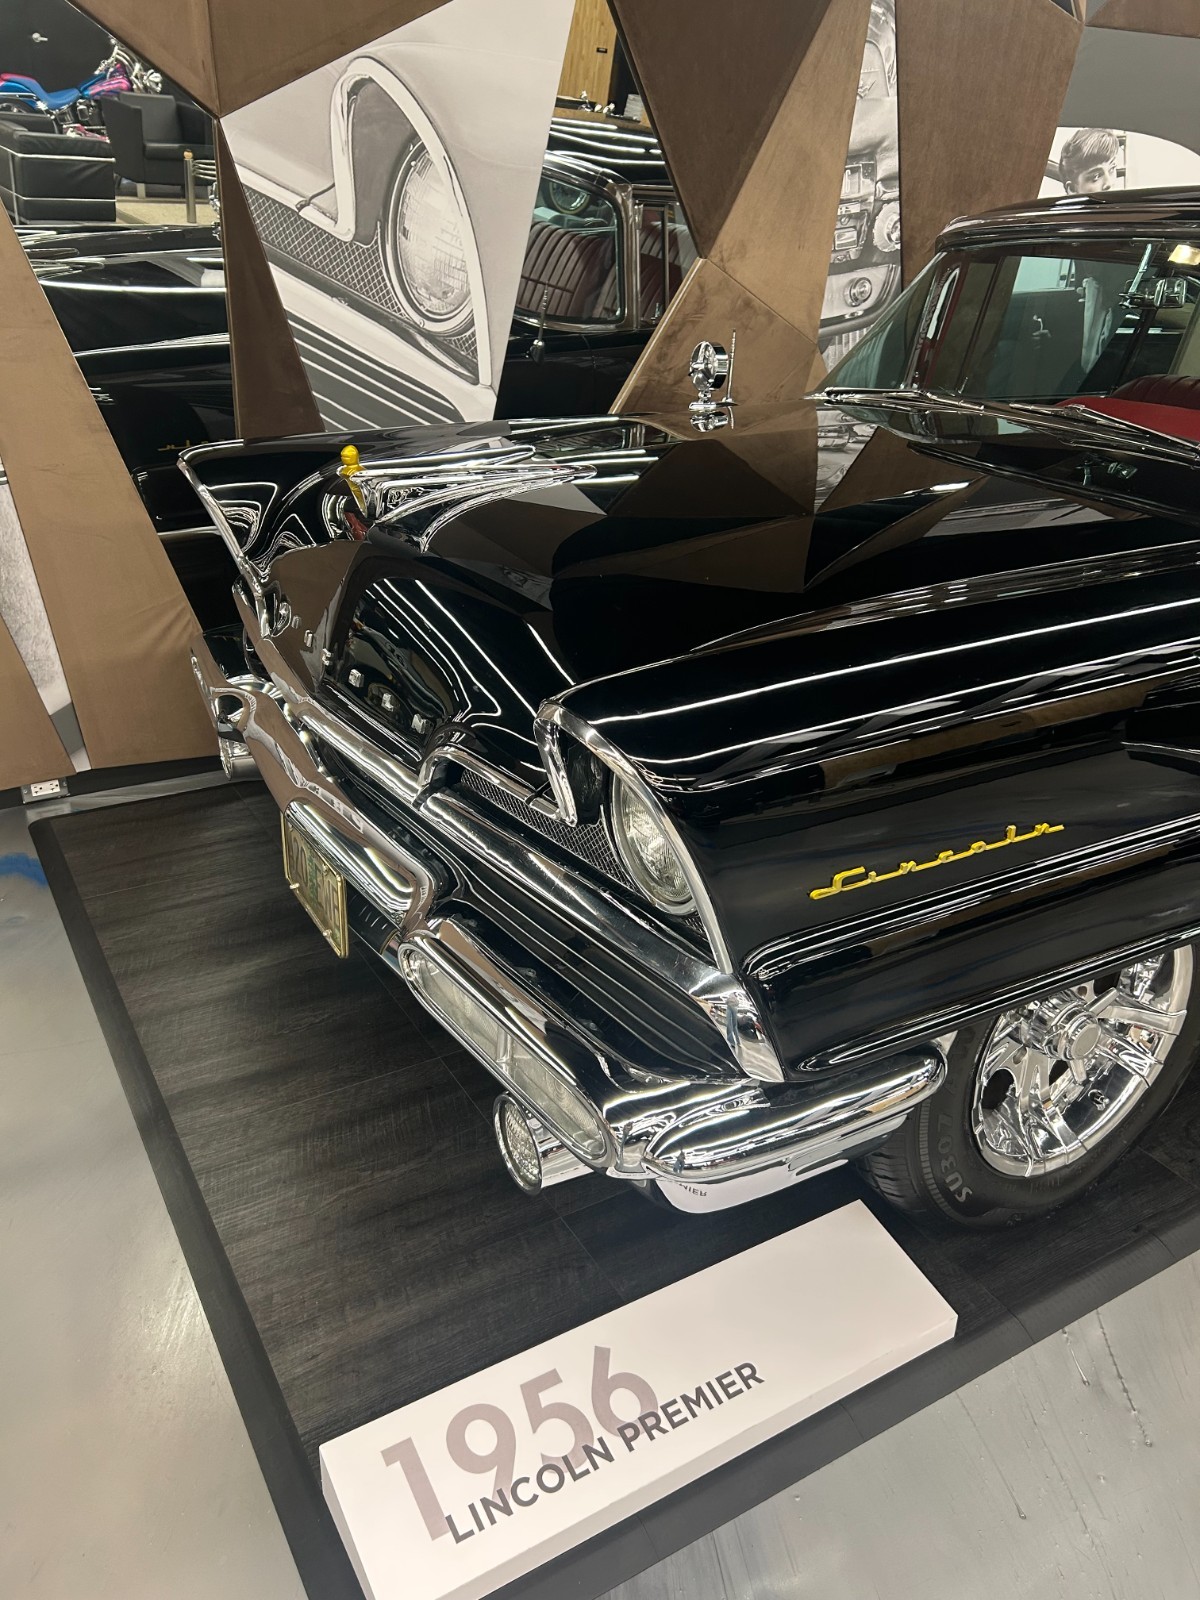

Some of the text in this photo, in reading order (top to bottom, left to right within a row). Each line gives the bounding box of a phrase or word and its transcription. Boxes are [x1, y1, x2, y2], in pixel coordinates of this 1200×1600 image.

[809, 824, 1065, 900] Lincoln
[937, 1114, 973, 1203] SU307
[380, 1345, 659, 1541] 1956
[445, 1362, 765, 1544] LINCOLN PREMIER
